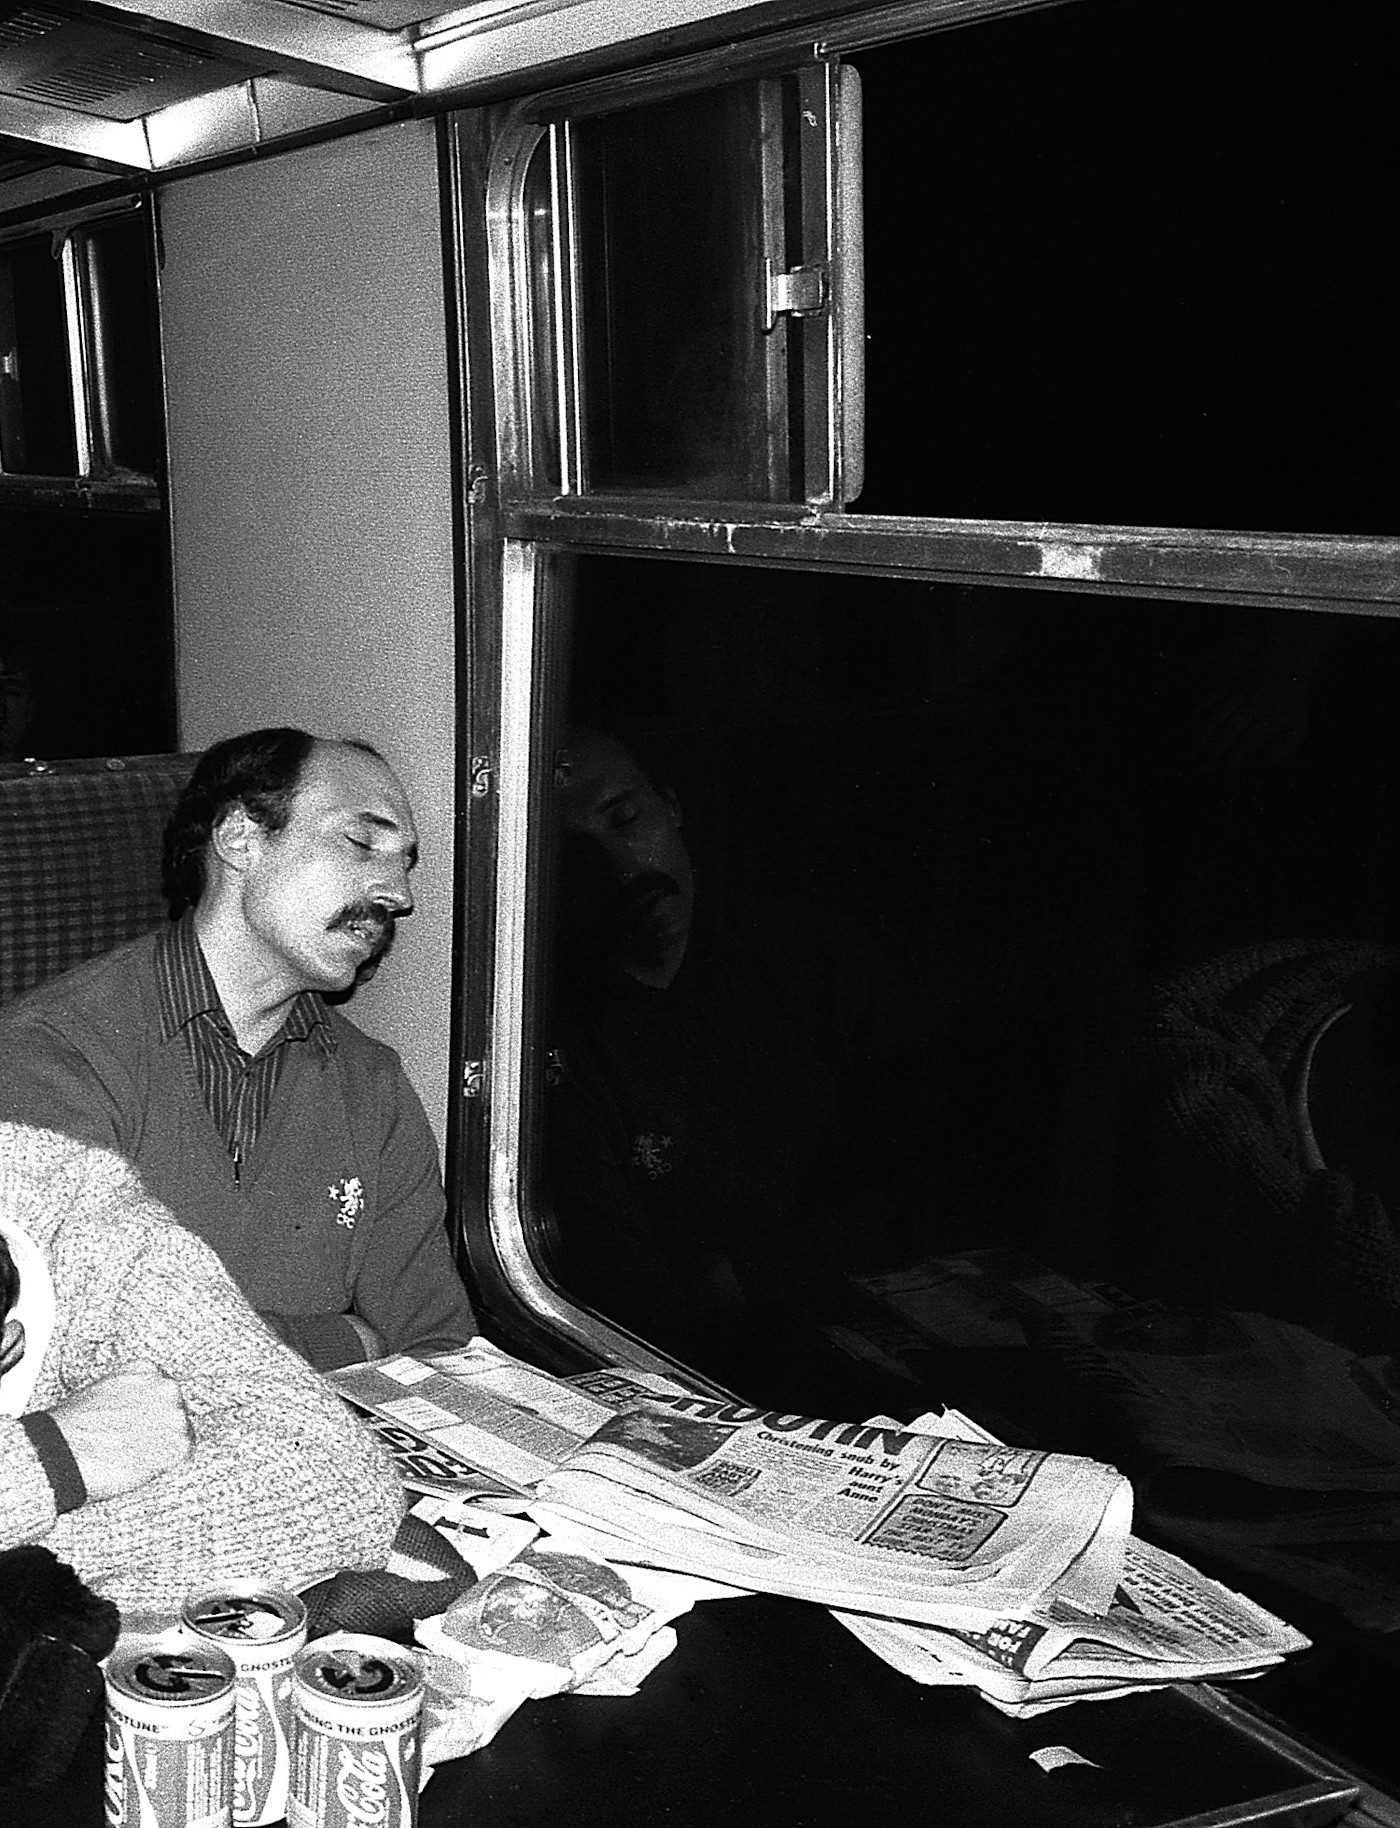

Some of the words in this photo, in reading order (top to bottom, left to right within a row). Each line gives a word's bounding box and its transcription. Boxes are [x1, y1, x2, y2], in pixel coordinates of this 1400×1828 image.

[757, 1431, 835, 1457] Christening
[840, 1451, 875, 1465] snub
[880, 1458, 901, 1471] by
[849, 1466, 903, 1486] Harry's
[849, 1480, 884, 1493] aunt
[836, 1487, 879, 1502] Anne
[336, 1723, 365, 1736] THE
